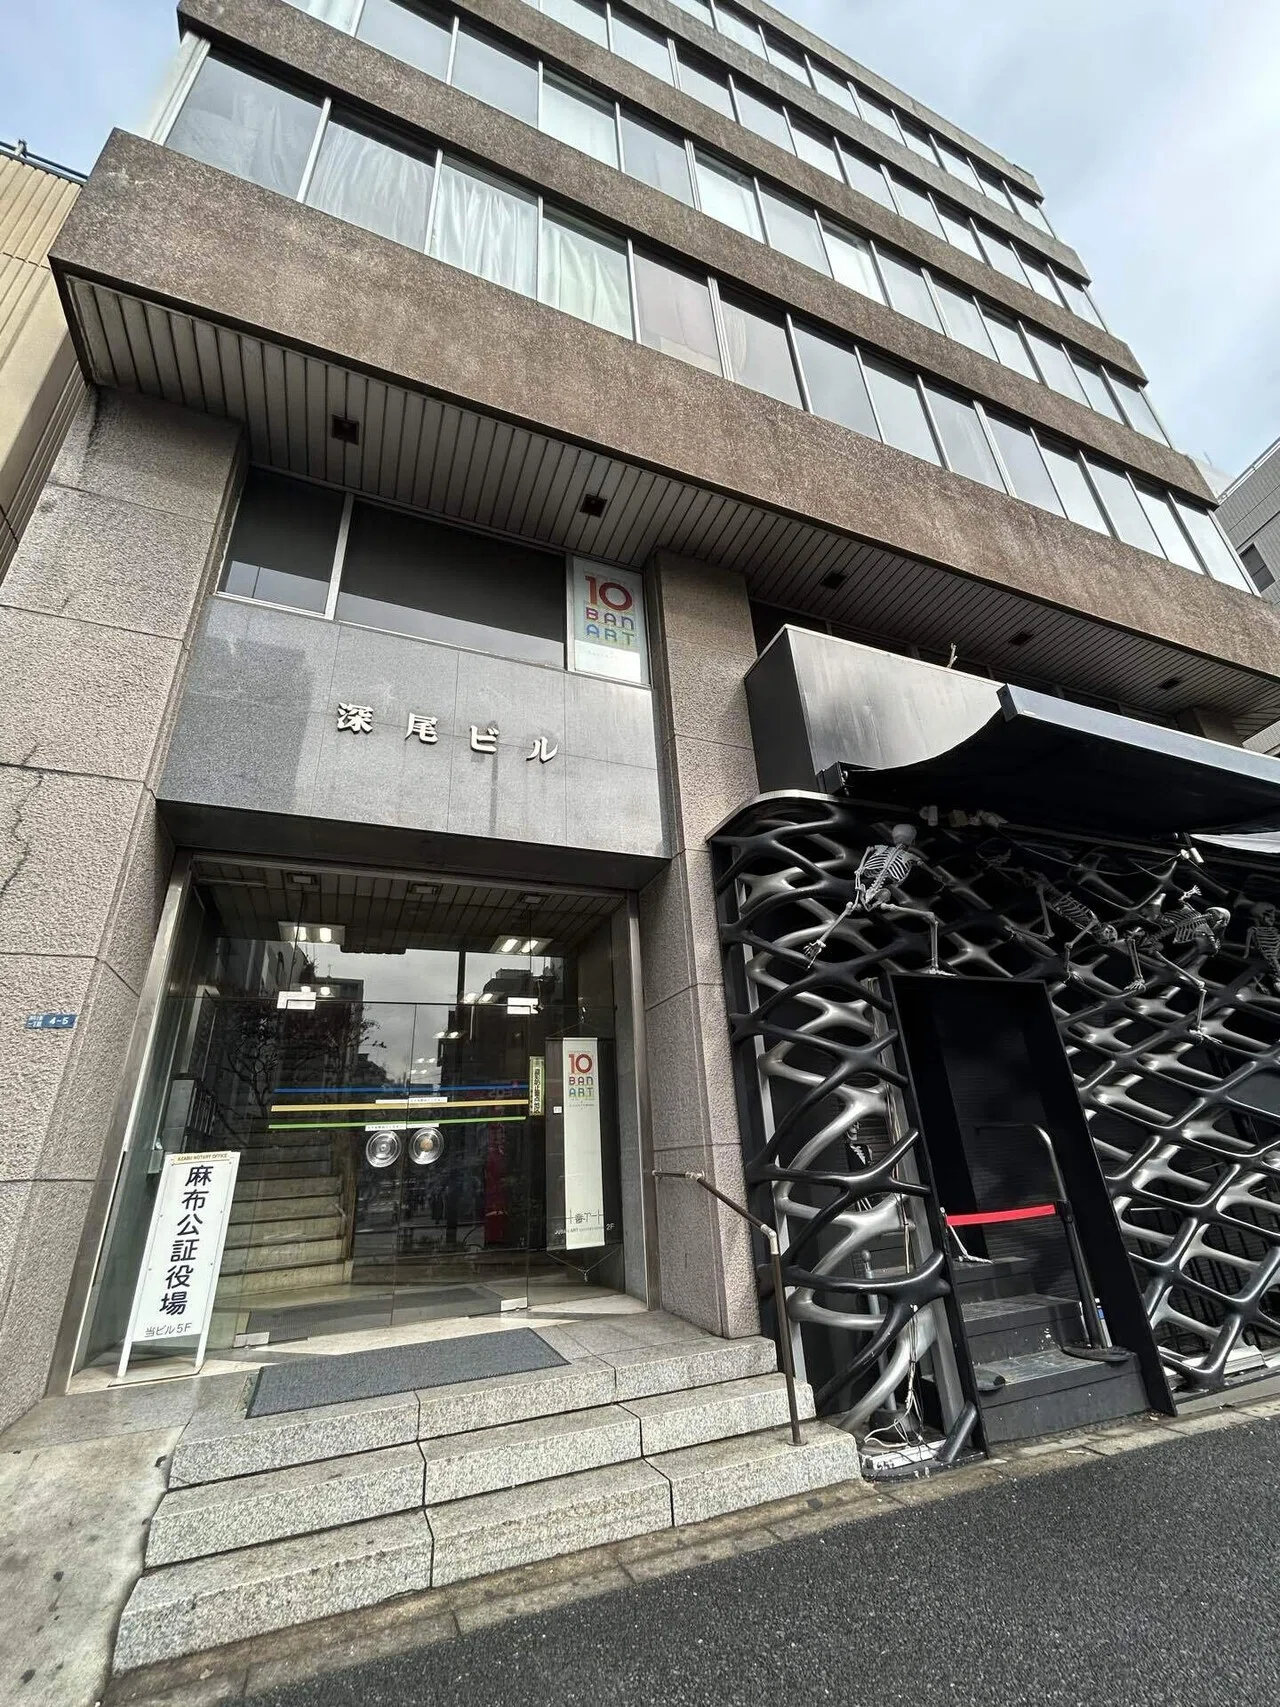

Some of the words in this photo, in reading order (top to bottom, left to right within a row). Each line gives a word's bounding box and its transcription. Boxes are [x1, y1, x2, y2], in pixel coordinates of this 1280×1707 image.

[585, 575, 633, 611] 10
[586, 607, 634, 631] BAN
[586, 624, 635, 645] ART
[337, 702, 558, 764] 深尾ビル
[568, 1053, 593, 1074] 10
[568, 1076, 594, 1086] BAN
[568, 1087, 595, 1097] ART
[158, 1165, 214, 1316] 麻布公証役場
